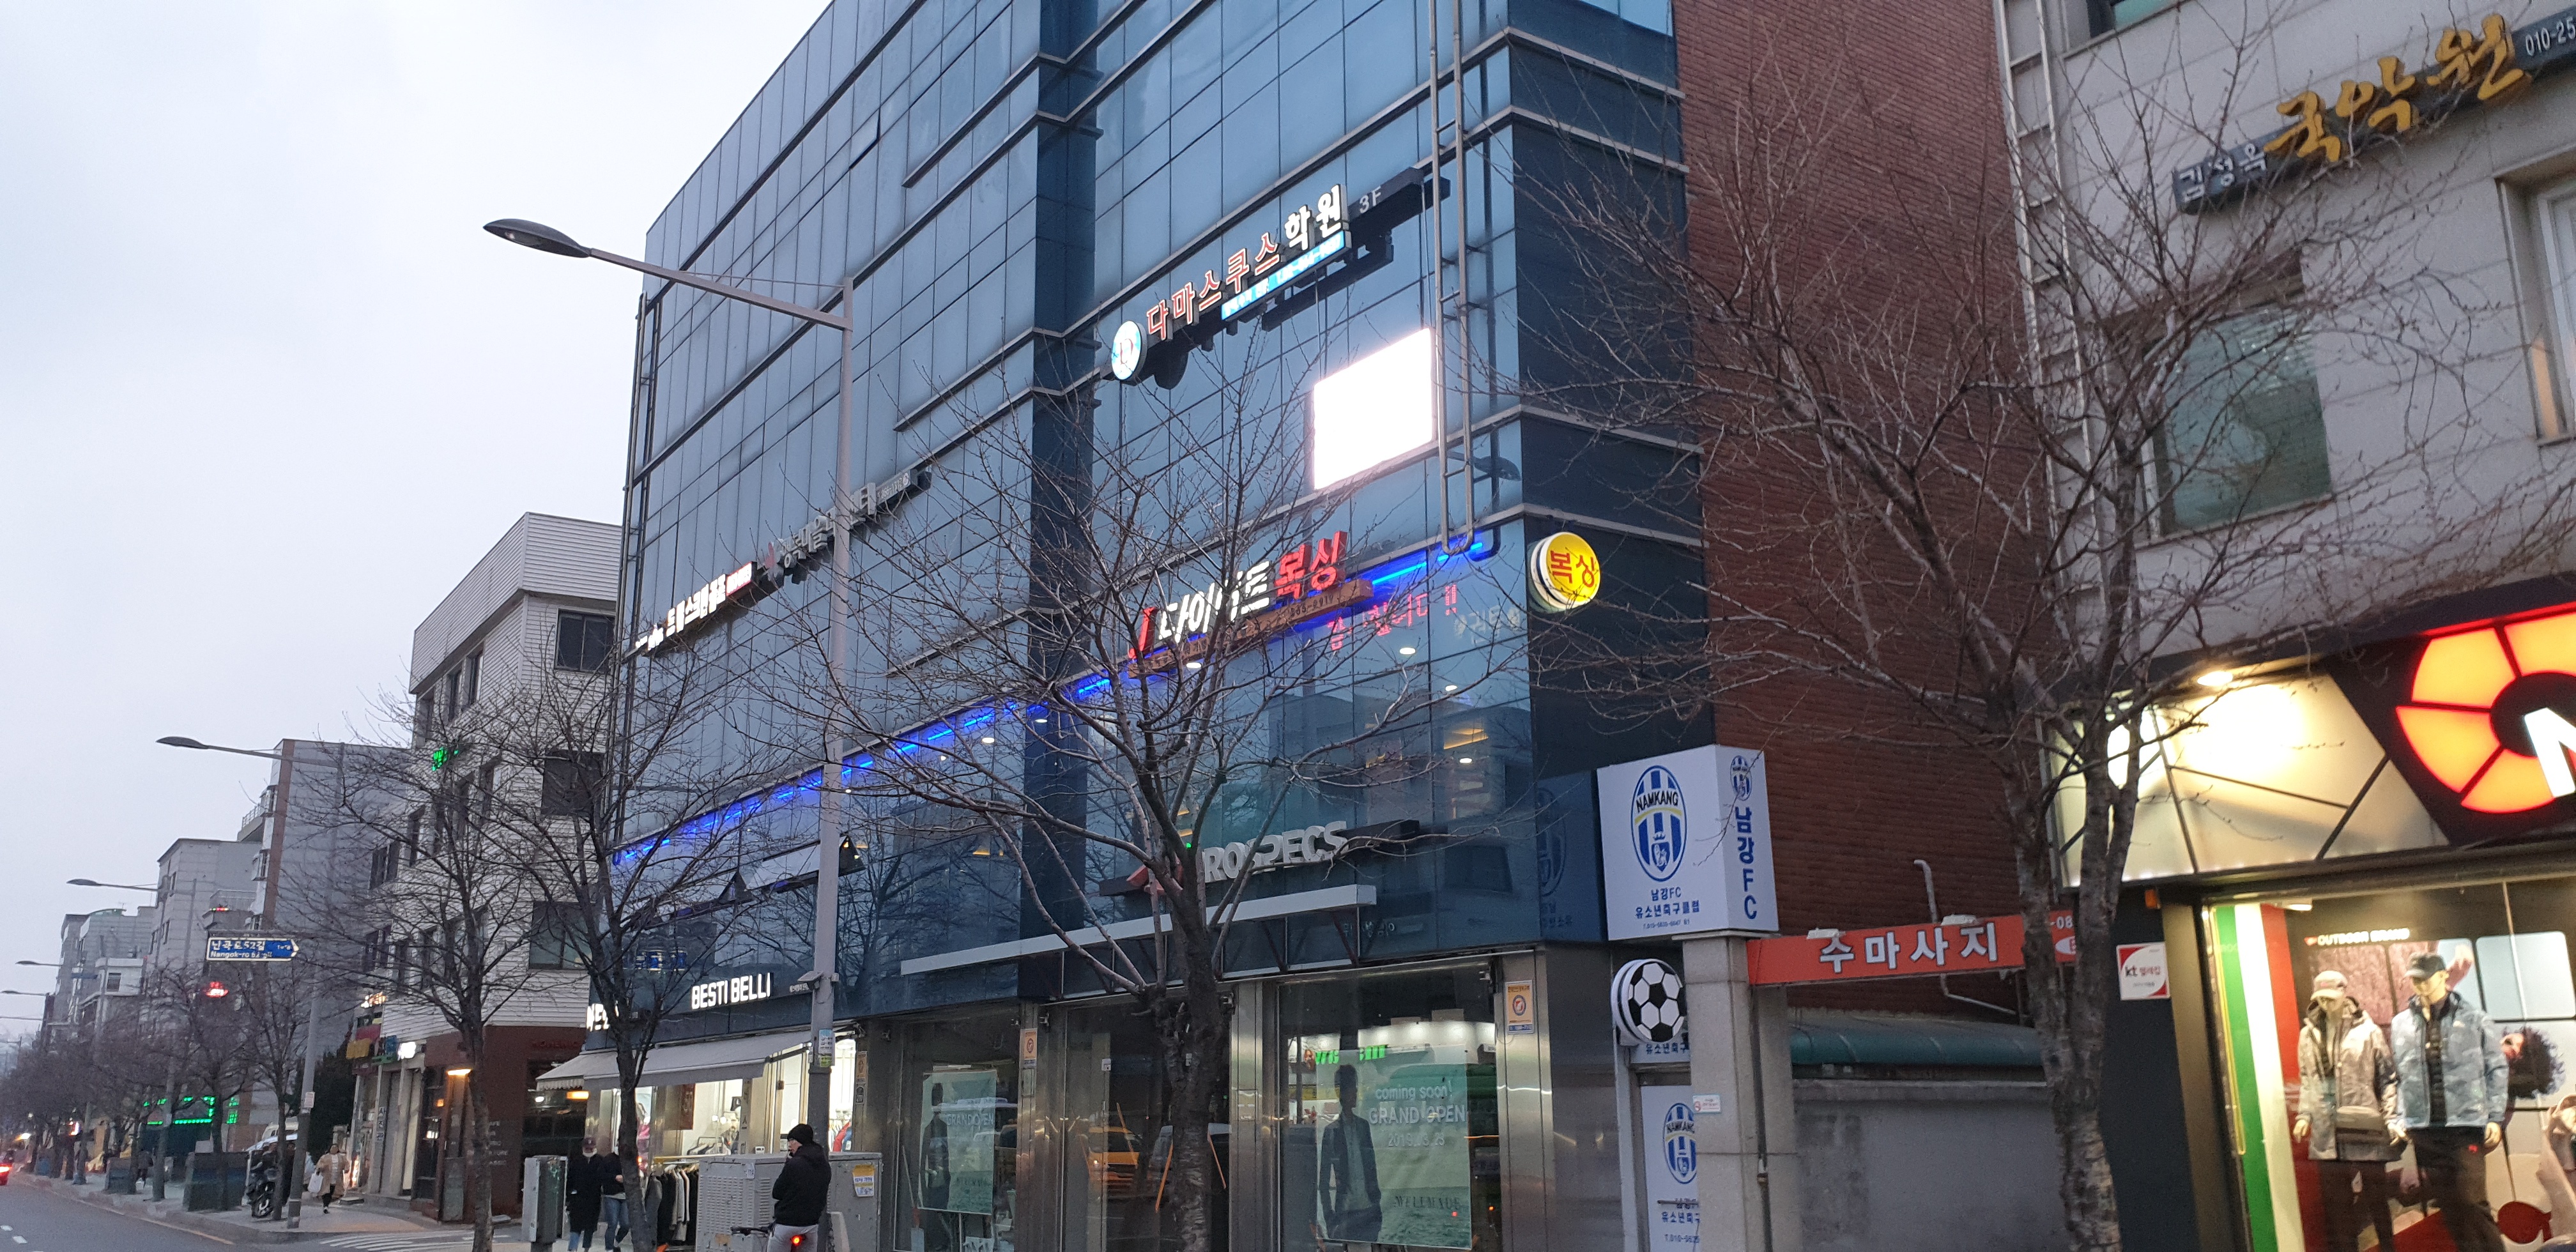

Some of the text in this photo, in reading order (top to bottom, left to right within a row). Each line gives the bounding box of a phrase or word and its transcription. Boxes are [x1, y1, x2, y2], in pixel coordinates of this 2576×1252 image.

[2264, 13, 2524, 163] 국악원
[1360, 186, 1382, 215] 3F
[1550, 550, 1595, 588] 복싱
[1636, 791, 1678, 813] NAMKANG
[691, 972, 770, 1010] BESTI BELLI
[1376, 1086, 1416, 1101] coming
[1369, 1104, 1466, 1124] GRAND OPEN
